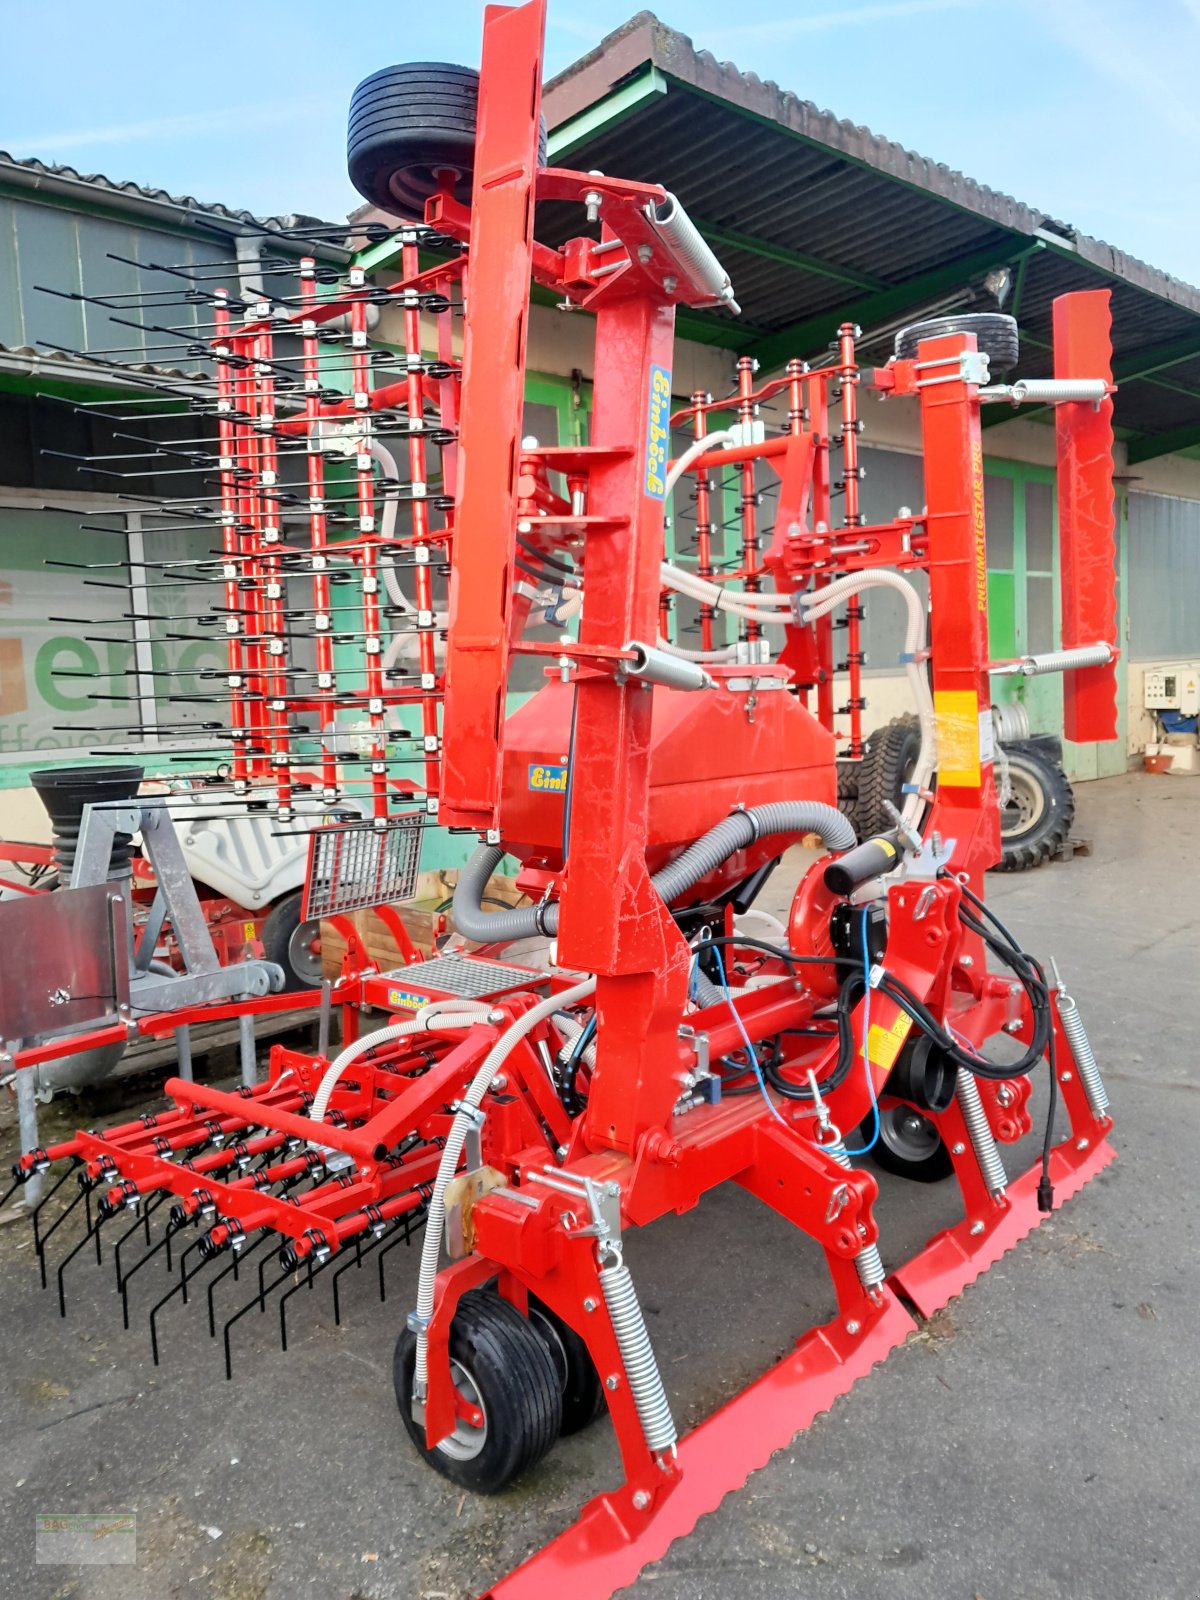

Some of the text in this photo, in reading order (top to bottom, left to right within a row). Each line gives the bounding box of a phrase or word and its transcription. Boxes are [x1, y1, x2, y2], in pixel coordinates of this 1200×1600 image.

[647, 370, 670, 495] Einböck
[972, 440, 987, 612] PNEUMATICSTAR PRO
